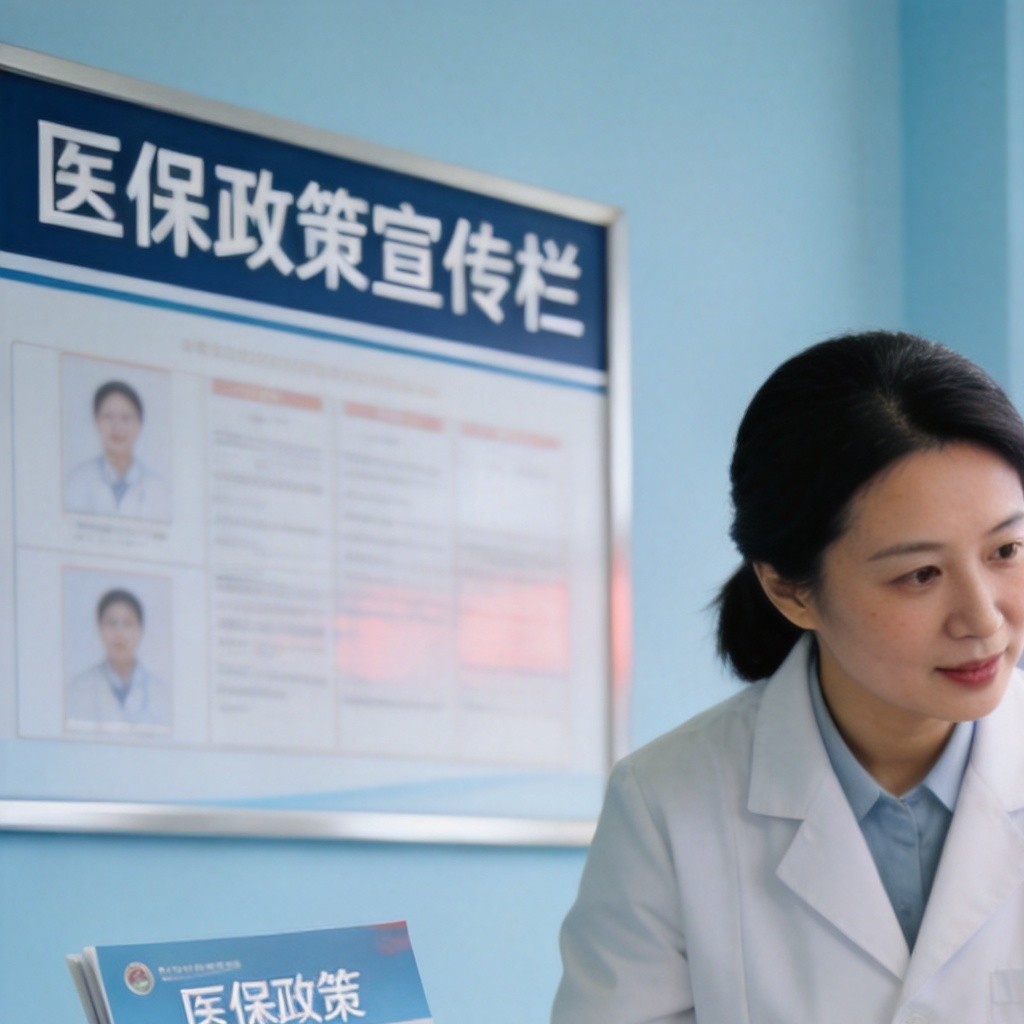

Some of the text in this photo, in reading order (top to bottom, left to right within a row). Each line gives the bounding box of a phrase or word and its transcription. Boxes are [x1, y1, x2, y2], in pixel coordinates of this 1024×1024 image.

[37, 119, 585, 337] 医保政策宣传栏
